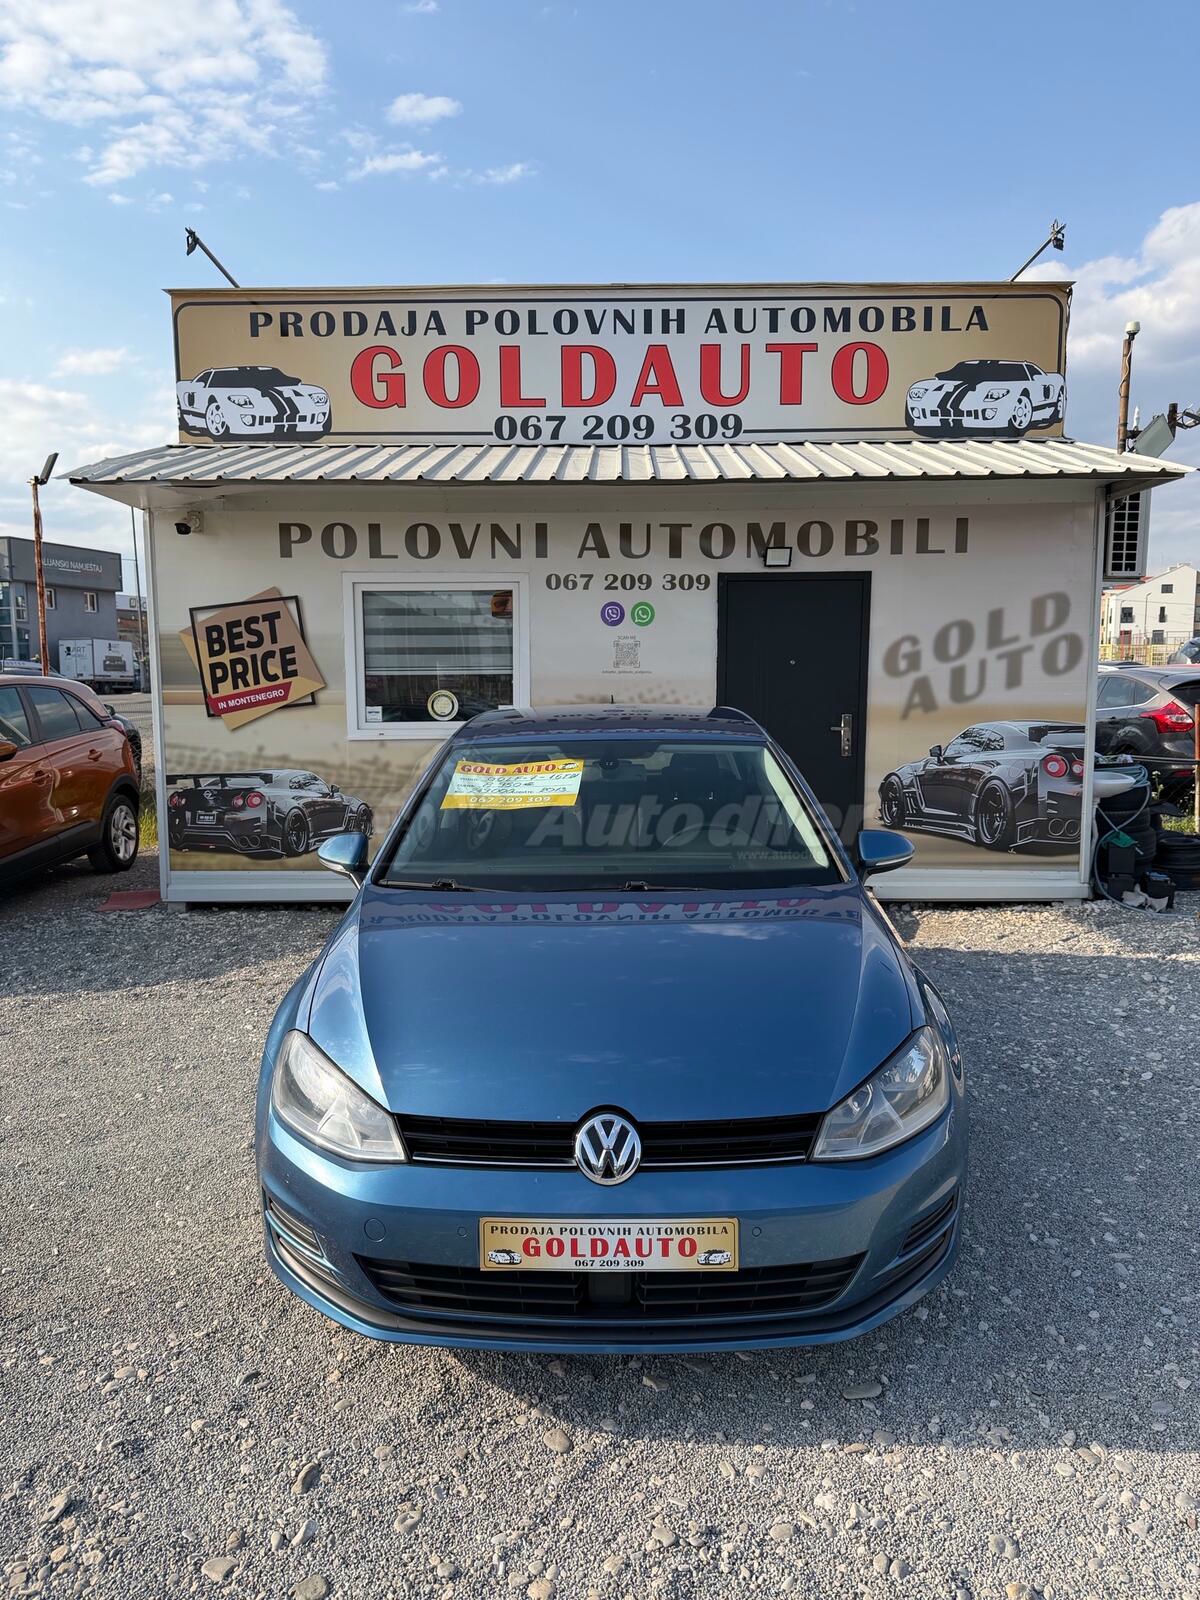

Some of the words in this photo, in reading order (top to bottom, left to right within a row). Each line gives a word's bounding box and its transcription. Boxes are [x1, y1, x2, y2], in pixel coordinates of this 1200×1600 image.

[249, 310, 447, 338] PRODAJA
[465, 307, 686, 336] POLOVNIH
[704, 305, 989, 334] AUTOMOBILA
[350, 341, 889, 410] GOLDAUTO
[494, 415, 566, 441] 067
[582, 414, 655, 441] 209
[670, 413, 743, 440] 309
[278, 522, 548, 559] POLOVNI
[577, 517, 969, 560] AUTOMOBILI
[545, 573, 593, 592] 067
[603, 573, 653, 592] 209
[662, 573, 711, 592] 309
[205, 611, 281, 658] BEST
[882, 591, 1072, 678] GOLD
[208, 645, 299, 695] PRICE
[901, 631, 1084, 720] AUTO
[218, 700, 227, 710] IN
[228, 689, 285, 708] MONTENEGRO
[460, 764, 507, 774] GOLD
[512, 763, 557, 774] AUTO
[490, 1225, 554, 1235] PRODAJA
[560, 1226, 632, 1236] POLOVNIH
[636, 1225, 729, 1236] AUTOMOBILA
[522, 1237, 698, 1258] GOLDAUTO
[574, 1259, 596, 1267] 067
[599, 1259, 620, 1267] 209
[623, 1259, 645, 1267] 309
